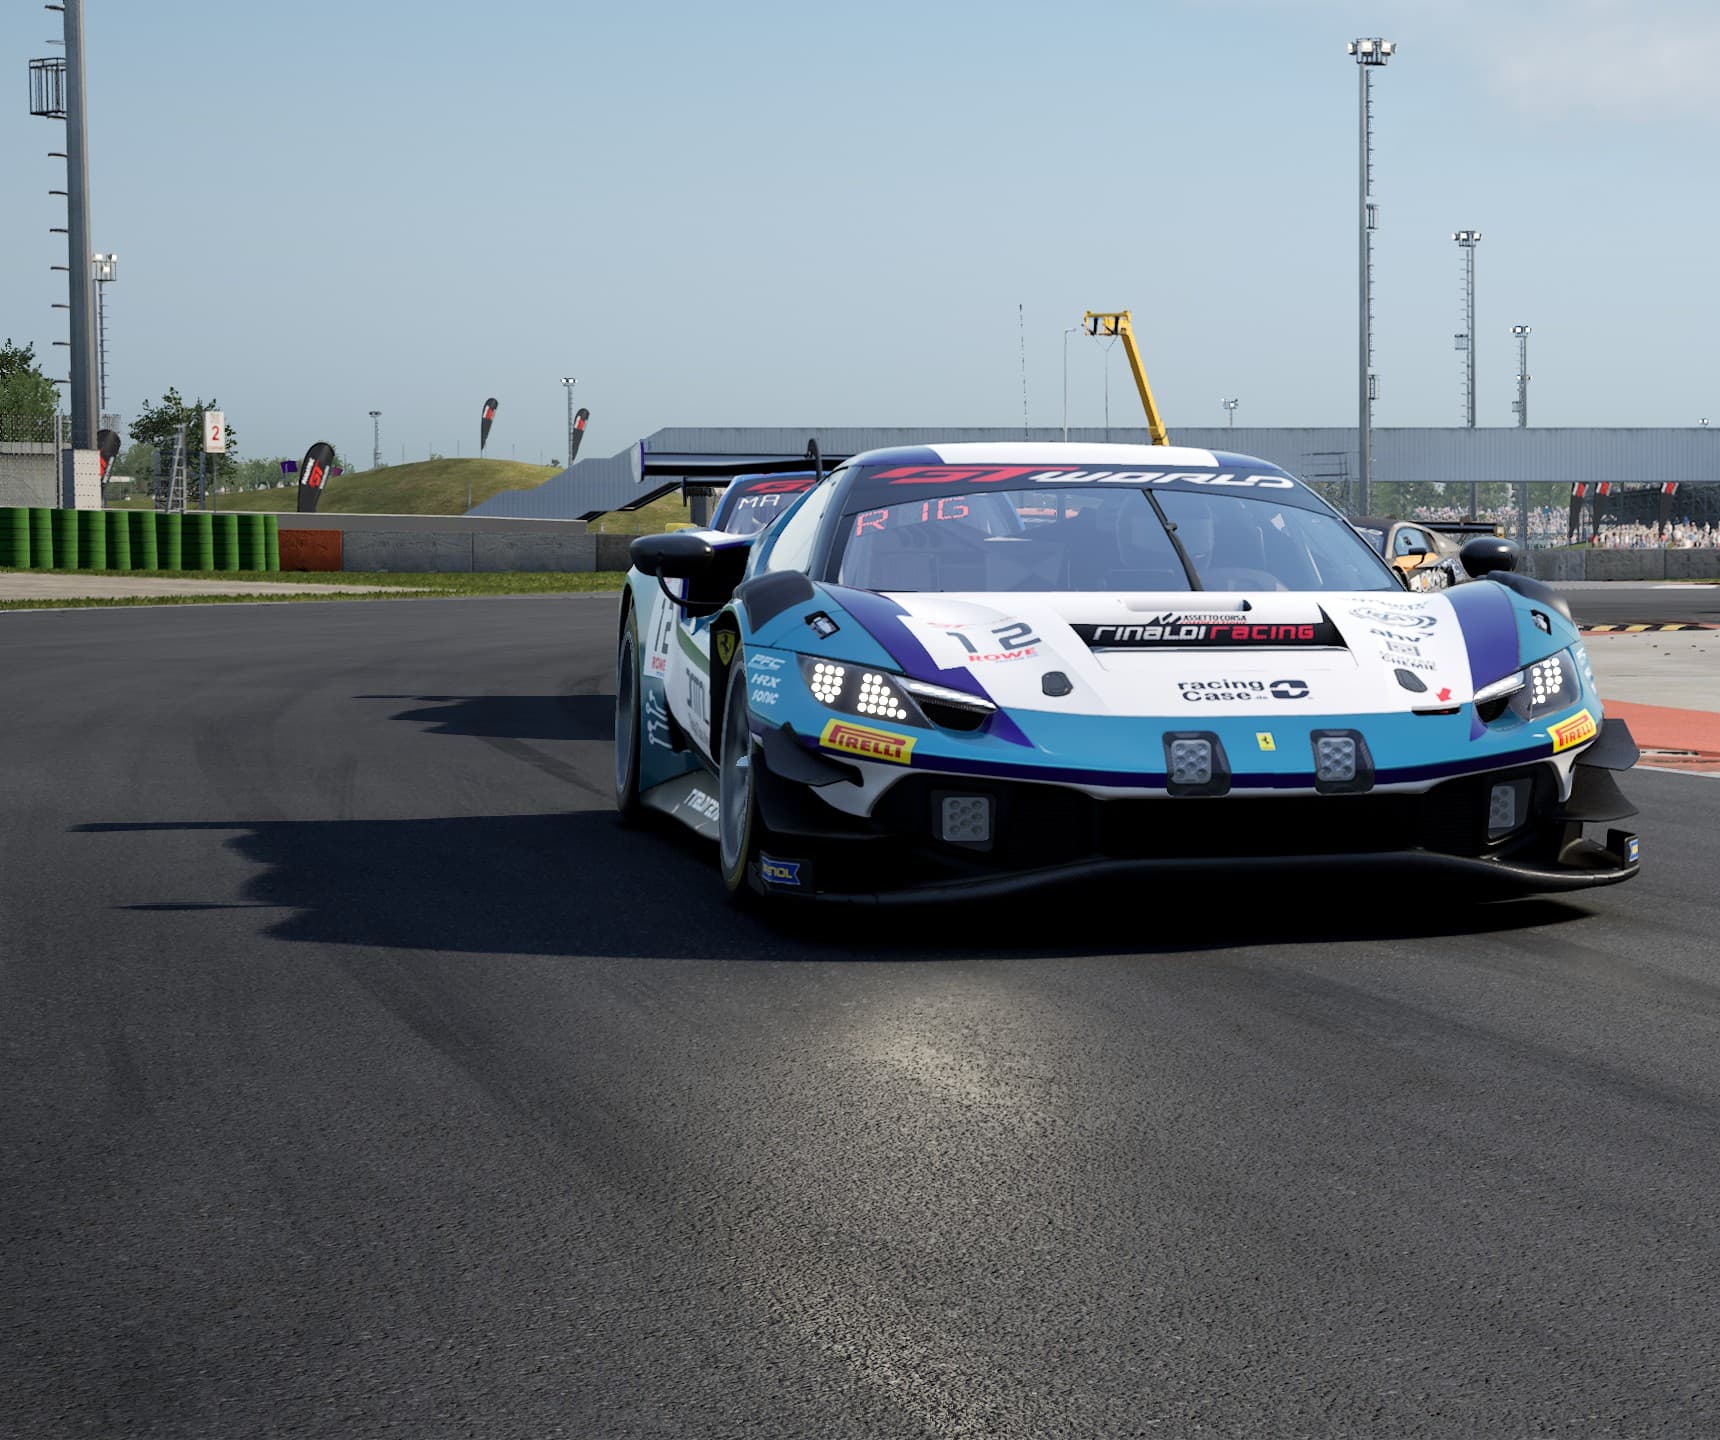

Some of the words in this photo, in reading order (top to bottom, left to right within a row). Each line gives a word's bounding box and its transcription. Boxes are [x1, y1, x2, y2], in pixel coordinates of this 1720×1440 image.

[212, 425, 220, 441] 2
[946, 622, 1041, 654] 12
[968, 647, 1036, 662] ROWE
[1177, 678, 1265, 692] racing
[1182, 690, 1251, 702] Case
[828, 724, 906, 758] PIRELLI
